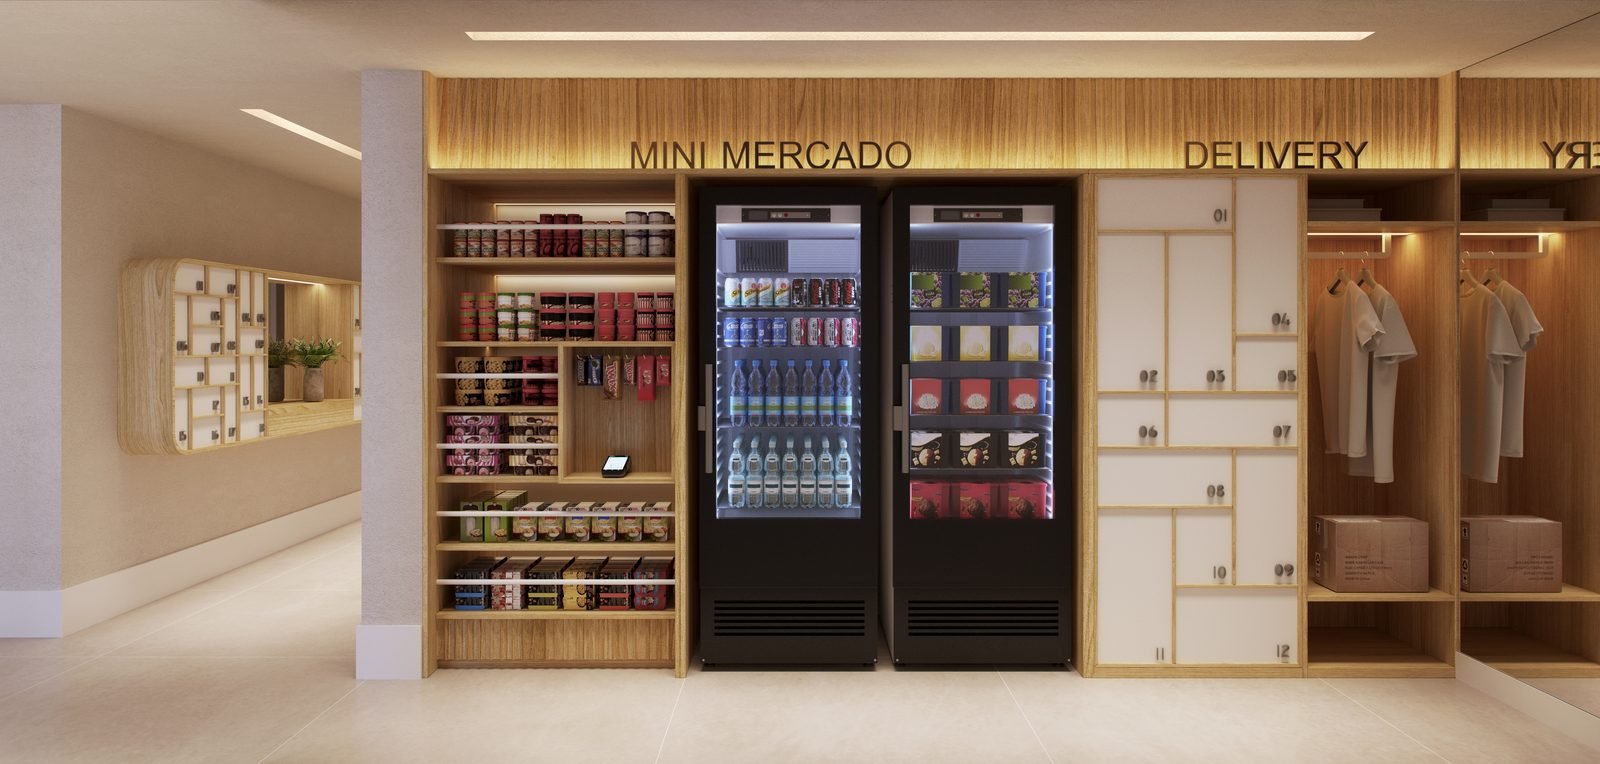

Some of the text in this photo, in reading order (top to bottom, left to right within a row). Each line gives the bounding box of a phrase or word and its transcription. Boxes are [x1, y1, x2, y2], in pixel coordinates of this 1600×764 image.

[630, 141, 912, 169] MINI MERCADO
[1184, 141, 1369, 169] DELIVERY
[1213, 208, 1227, 222] 01
[1271, 313, 1290, 326] 04
[606, 360, 618, 392] TWIX
[1140, 369, 1158, 383] 02
[1206, 369, 1225, 383] 03
[1277, 369, 1297, 383] 05
[1138, 425, 1158, 438] 06
[1273, 425, 1292, 438] 07
[1206, 485, 1225, 498] 08
[1213, 565, 1227, 579] 10
[1274, 564, 1294, 577] 09
[1156, 647, 1165, 660] 11
[1277, 644, 1290, 657] 12
